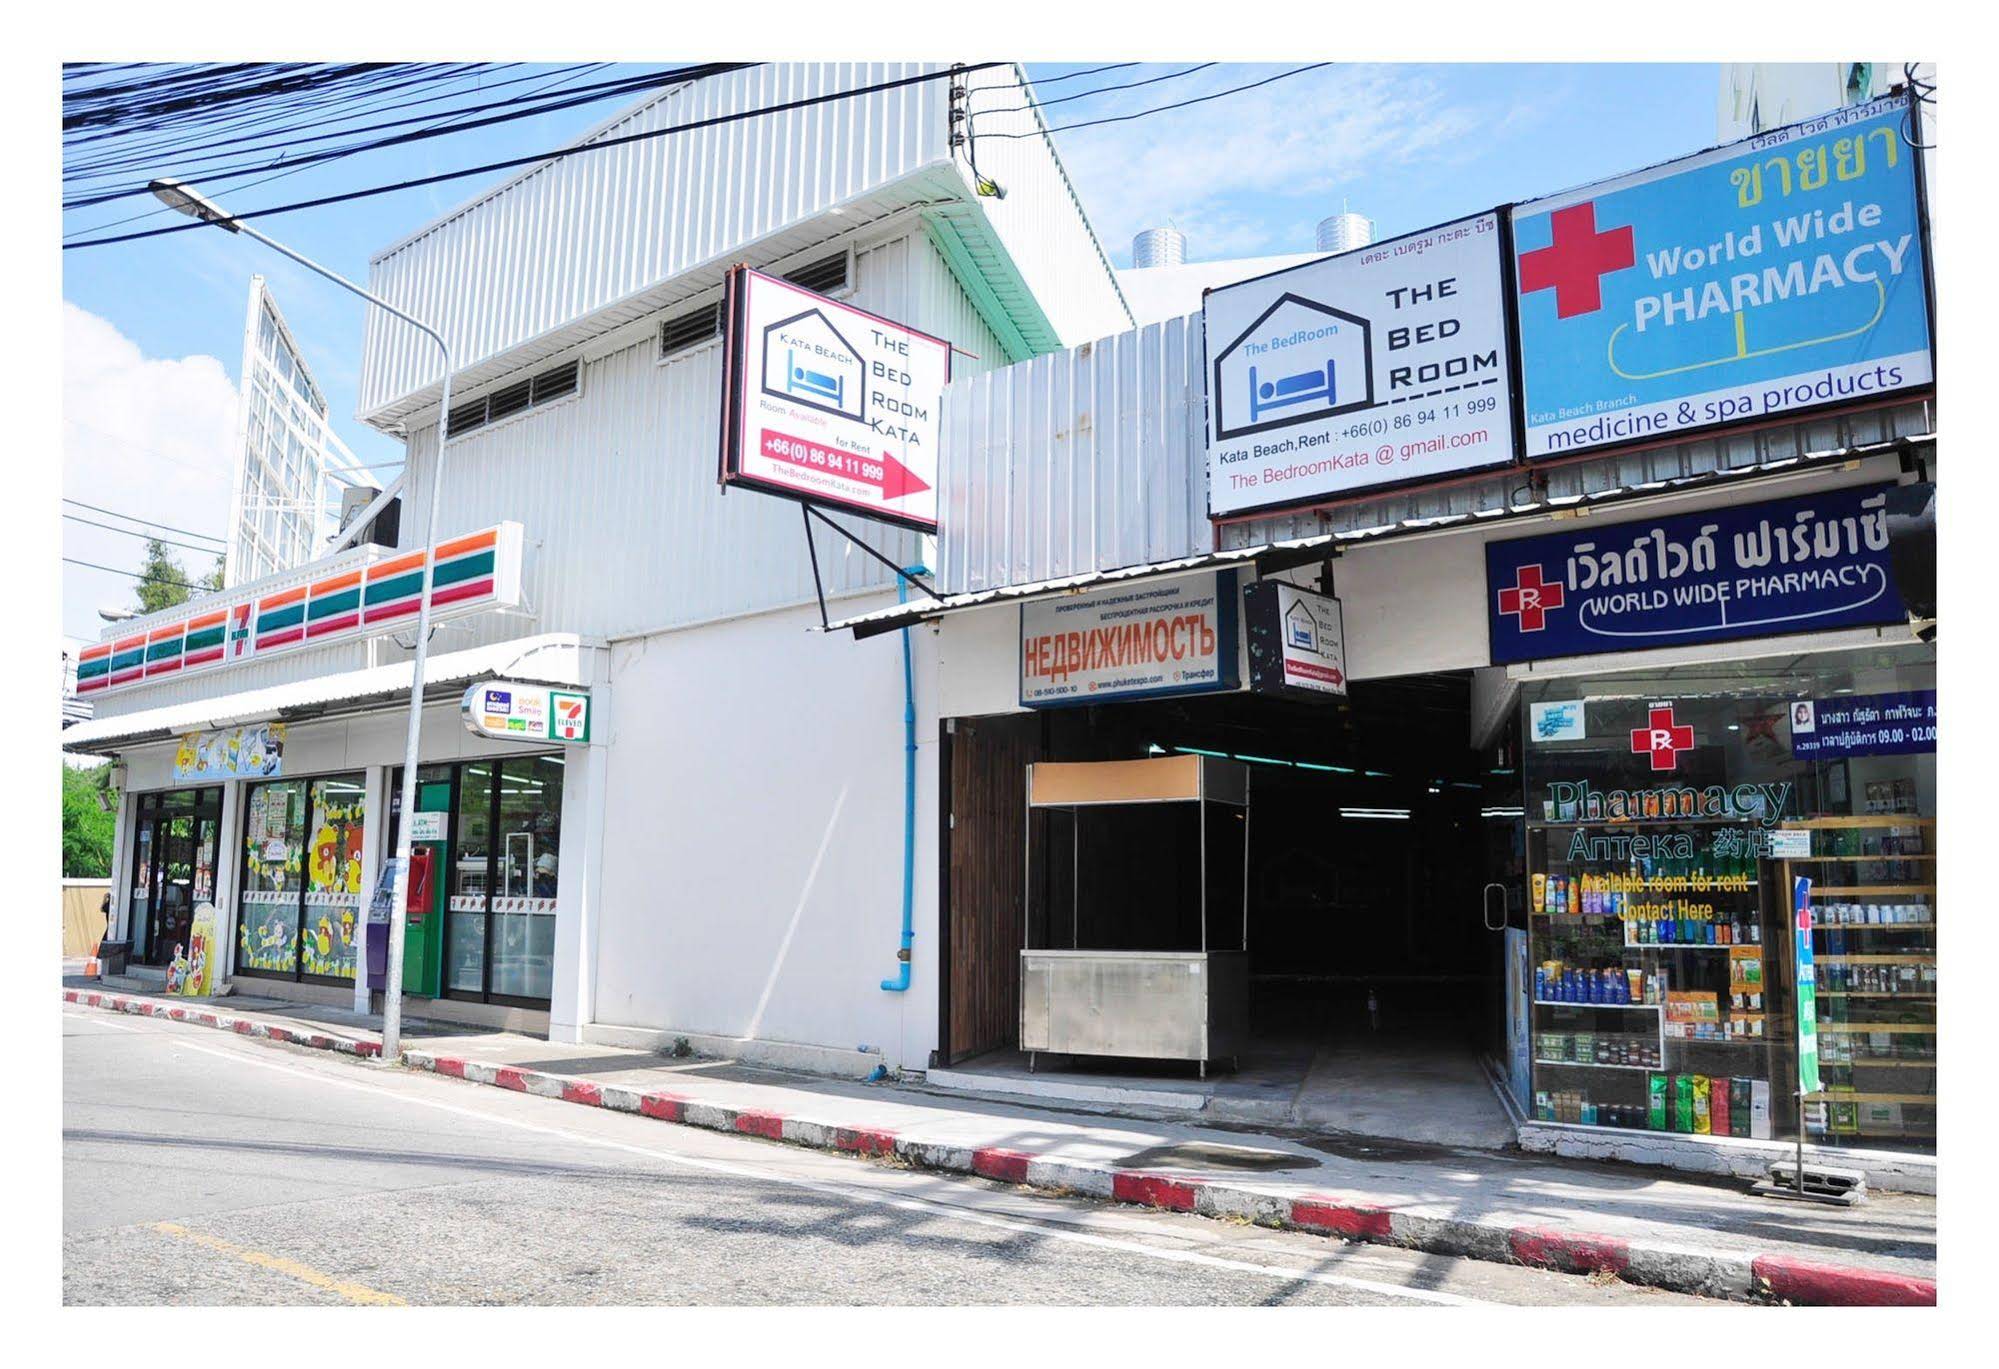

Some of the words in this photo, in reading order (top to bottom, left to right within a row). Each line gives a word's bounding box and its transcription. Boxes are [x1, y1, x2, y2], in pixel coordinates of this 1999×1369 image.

[1730, 126, 1899, 208] ขายยา
[1646, 225, 1763, 279] World
[1773, 201, 1883, 248] Wide
[1386, 278, 1458, 310] THE
[1634, 233, 1912, 333] PHARMACY
[780, 333, 811, 352] KATA
[814, 345, 853, 366] BEACH
[871, 330, 910, 357] THE
[1244, 341, 1268, 357] The
[1271, 325, 1339, 351] BedRoom
[1388, 318, 1462, 352] BED
[872, 361, 913, 387] BED
[1390, 350, 1499, 390] ROOM
[760, 400, 786, 415] Room
[872, 392, 928, 422] ROOM
[1531, 409, 1557, 425] Kata
[1559, 401, 1594, 421] Beach
[1596, 393, 1637, 415] Branch
[1547, 406, 1669, 450] medicine
[1677, 400, 1697, 425] &
[1704, 391, 1754, 425] spa
[1763, 364, 1904, 418] products
[835, 436, 849, 446] for
[851, 441, 871, 454] Rent
[871, 417, 921, 446] KATA
[1219, 448, 1249, 465] Kata
[1341, 419, 1389, 441] +66(0)
[1393, 413, 1412, 430] 86
[1417, 408, 1436, 425] 94
[1443, 404, 1461, 420] 11
[1466, 396, 1498, 416] 999
[810, 449, 826, 466] 86
[828, 453, 843, 470] 94
[846, 458, 859, 474] 11
[862, 463, 884, 481] 999
[1229, 471, 1259, 491] The
[1262, 452, 1370, 484] BedroomKata
[1374, 444, 1396, 466] @
[1399, 428, 1489, 461] gmail.com
[1589, 588, 1669, 617] WORLD
[1673, 581, 1731, 604] WIDE
[1736, 563, 1874, 600] PHARMACY
[1024, 613, 1216, 683] НЕДВИЖИМОСТЬ
[559, 700, 583, 739] 7
[1878, 729, 1904, 744] 09.00
[1911, 726, 1937, 742] 02.00
[1547, 779, 1793, 826] Pharmacy
[1567, 831, 1693, 862] Аптека
[1712, 827, 1777, 860] 药店
[1580, 871, 1645, 894] Available
[1647, 875, 1688, 893] room
[1690, 870, 1714, 892] for
[1716, 874, 1749, 893] rent
[1617, 898, 1674, 922] Contact
[1677, 899, 1714, 921] Here
